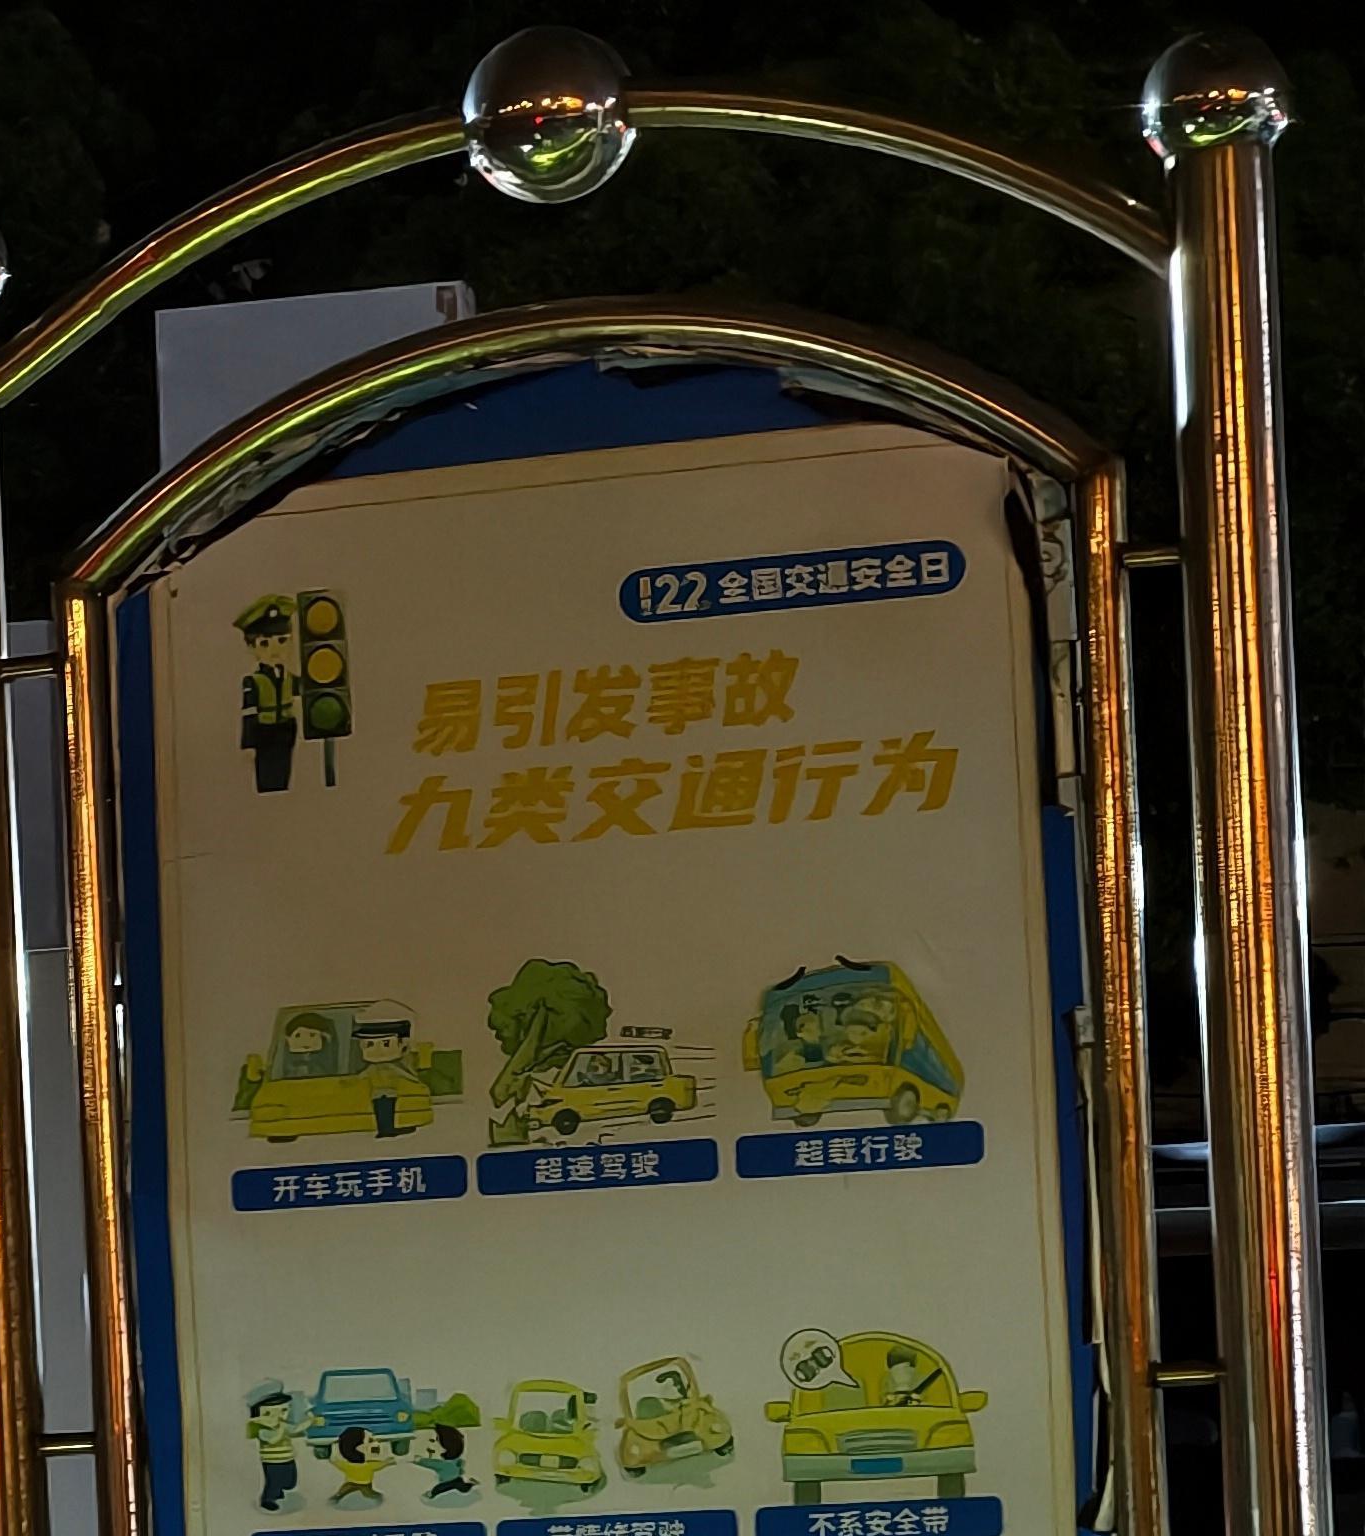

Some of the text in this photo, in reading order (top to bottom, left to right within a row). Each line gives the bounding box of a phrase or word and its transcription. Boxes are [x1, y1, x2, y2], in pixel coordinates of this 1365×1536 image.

[718, 550, 950, 604] 全国交通安全日
[411, 648, 801, 756] 易引发事故
[384, 729, 961, 856] 九类交通行为
[534, 1149, 662, 1186] 超速驾驶
[794, 1133, 924, 1169] 超载行驶
[271, 1166, 429, 1203] 开车玩手机
